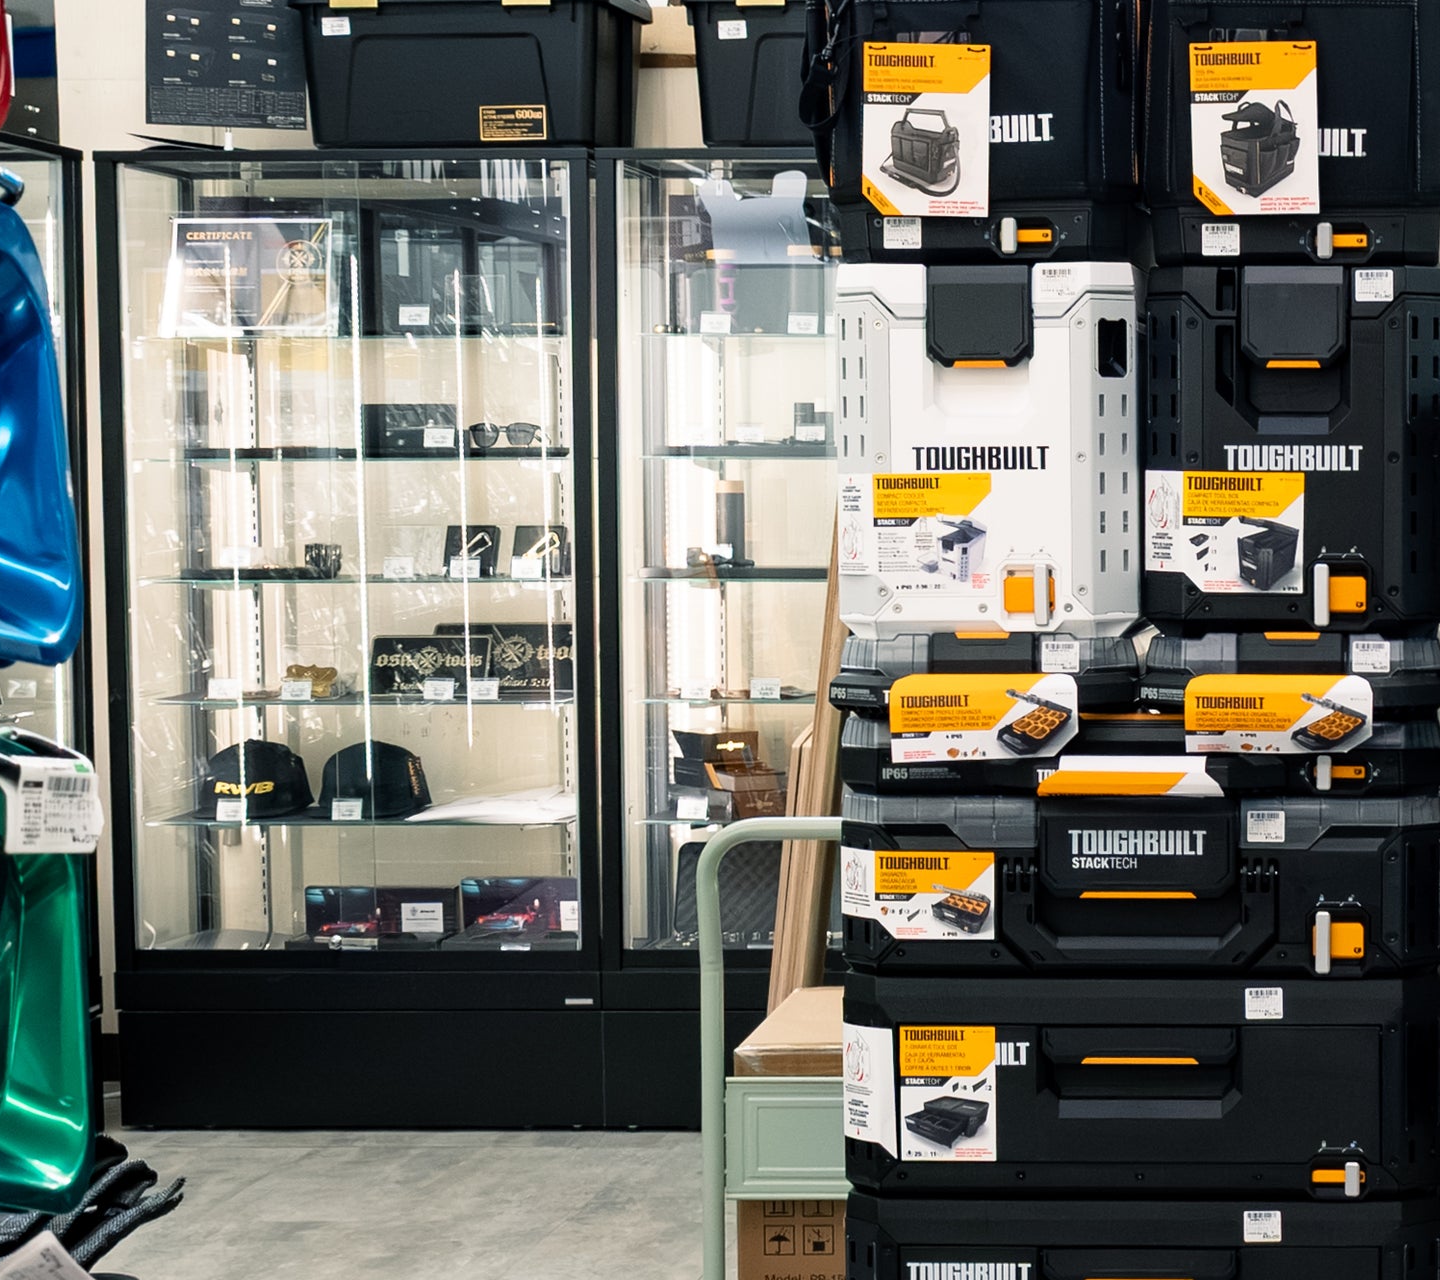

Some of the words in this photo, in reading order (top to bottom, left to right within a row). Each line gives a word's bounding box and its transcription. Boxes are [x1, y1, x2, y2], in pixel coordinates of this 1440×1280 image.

[868, 54, 936, 68] TOUGHBUILT
[1193, 52, 1262, 67] TOUGHBUILT
[867, 94, 912, 104] STACKTECH
[1194, 92, 1239, 103] STACKTECH
[185, 230, 254, 242] CERTIFICATE
[912, 444, 1050, 472] TOUGHBUILT
[1223, 443, 1363, 472] TOUGHBUILT
[875, 477, 941, 490] TOUGHBUILT
[1187, 476, 1264, 492] TOUGHBUILT
[900, 694, 970, 710] TOUGHBUILT
[1194, 694, 1265, 710] TOUGHBUILT
[881, 766, 908, 781] IP65
[1068, 828, 1208, 857] TOUGHBUILT
[878, 855, 951, 873] TOUGHBUILT
[1071, 857, 1139, 871] STACKTECH
